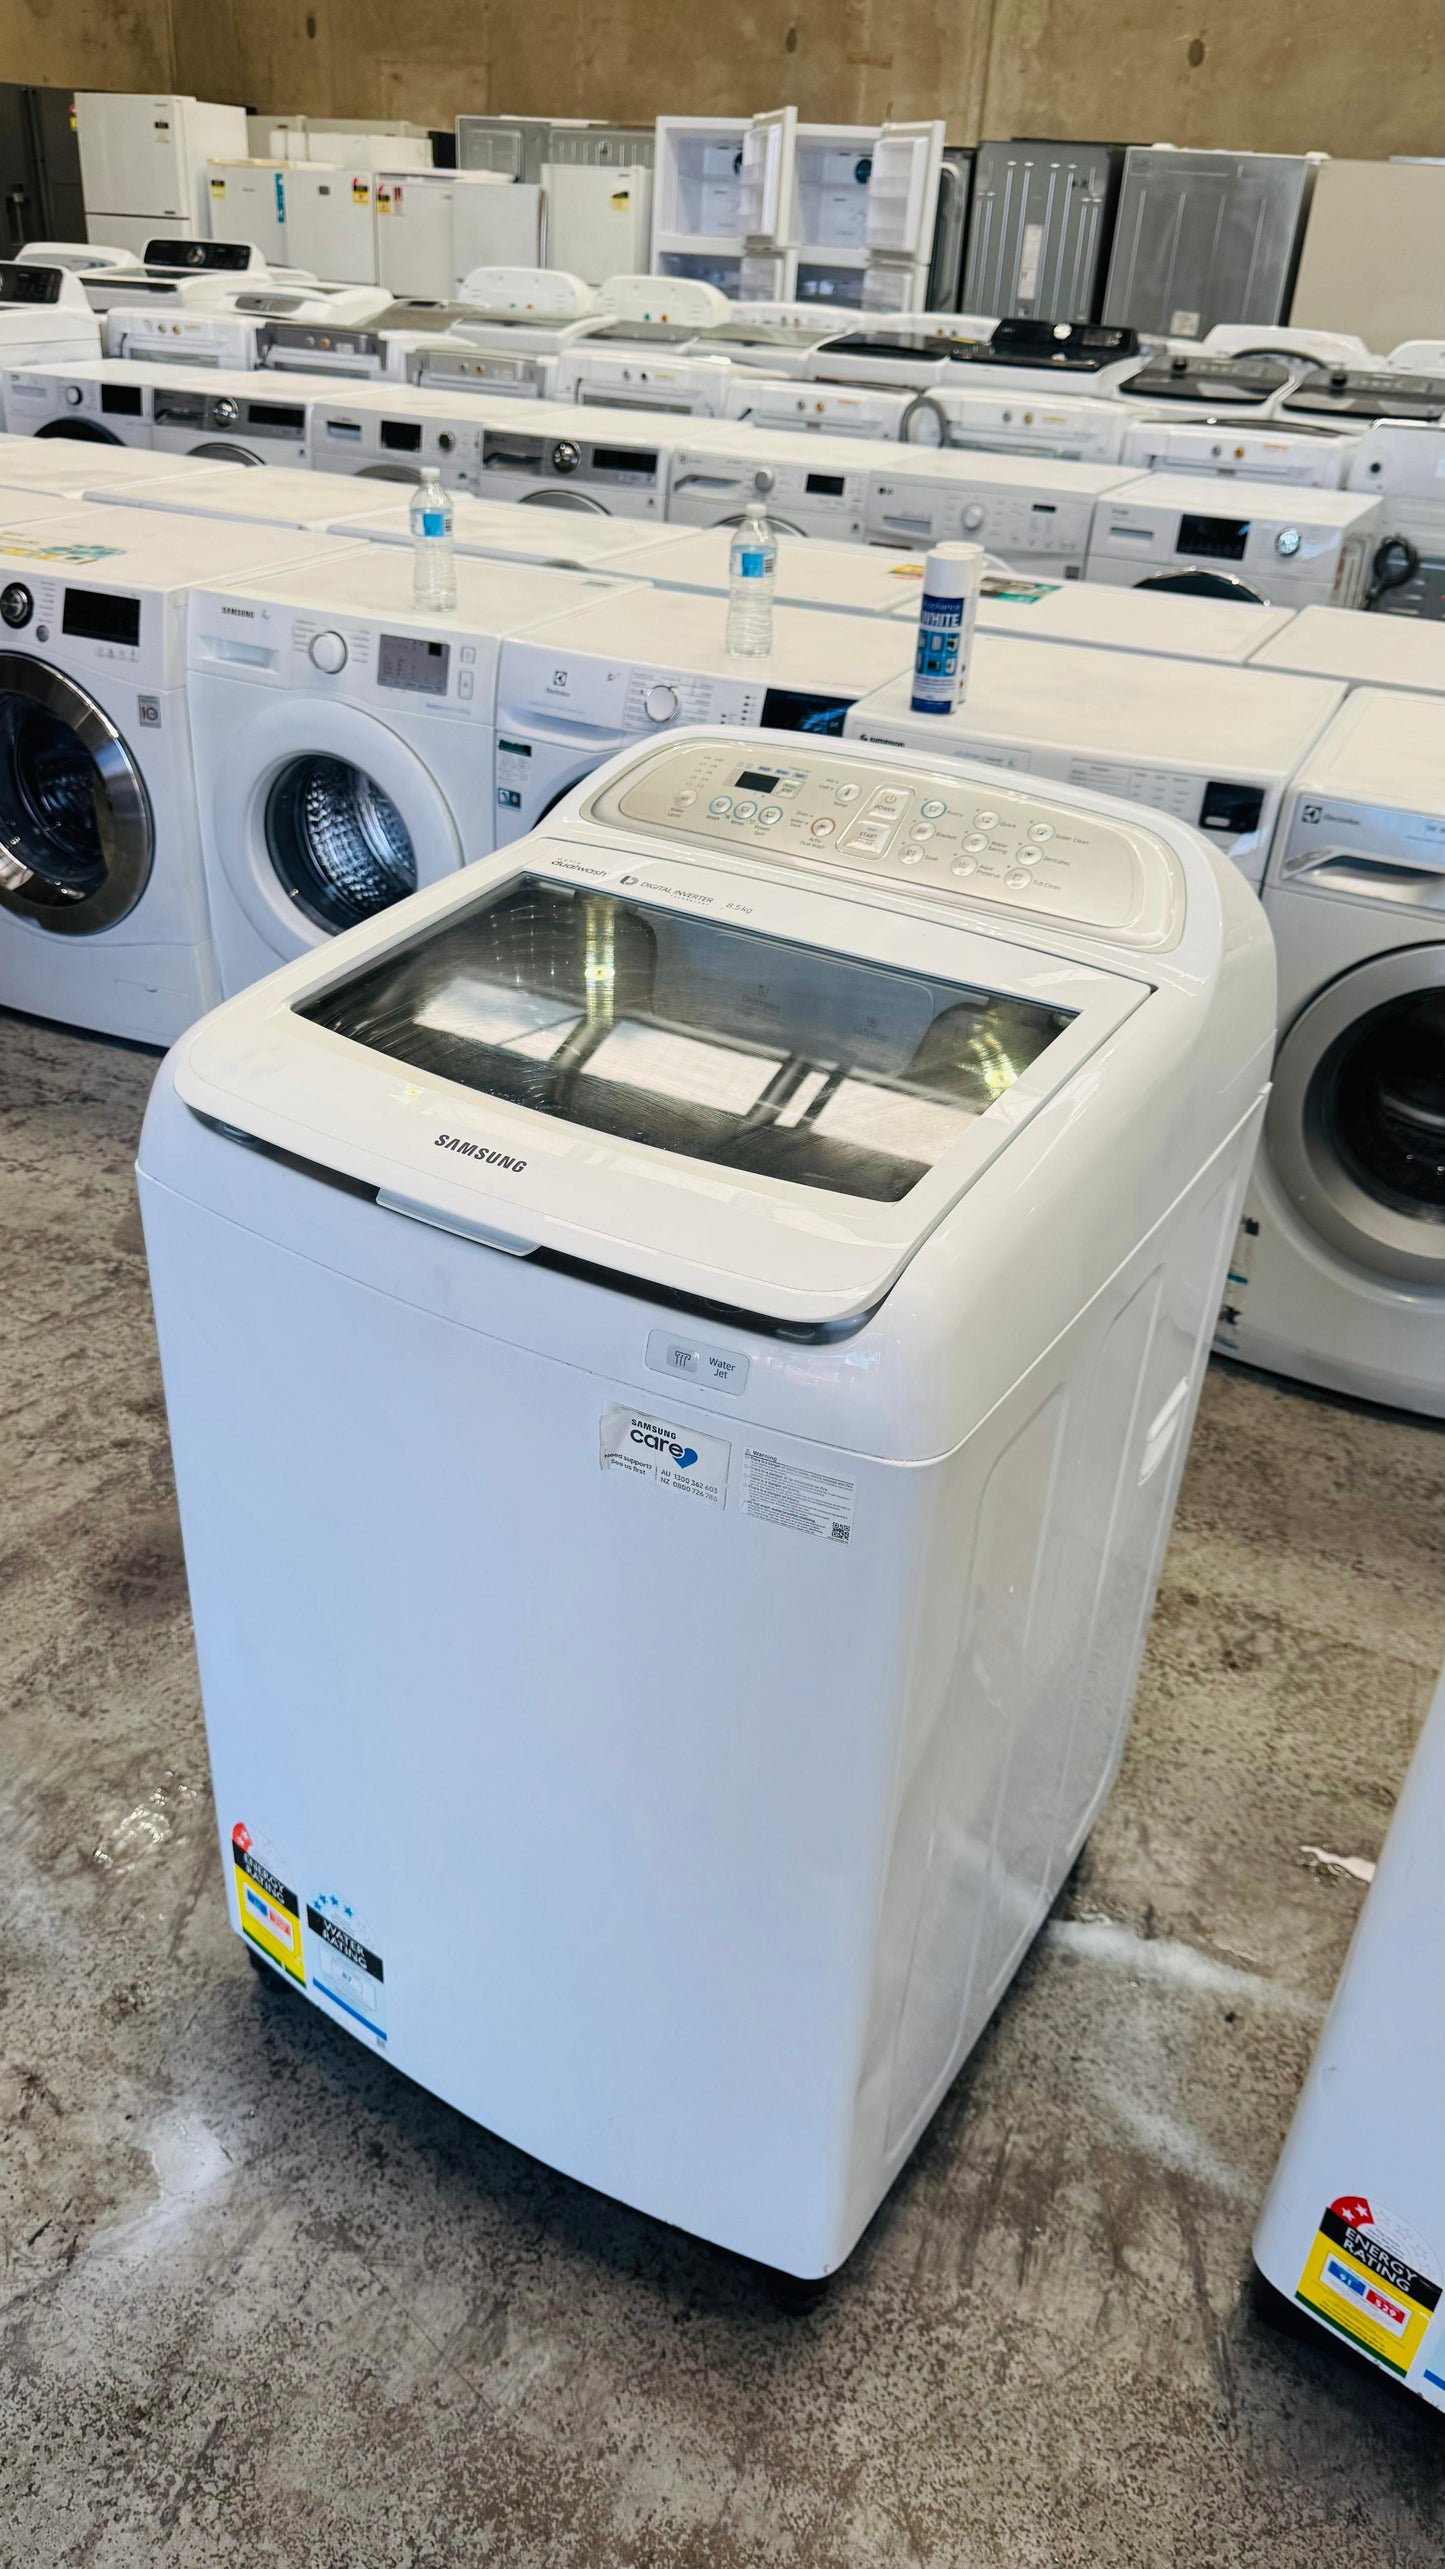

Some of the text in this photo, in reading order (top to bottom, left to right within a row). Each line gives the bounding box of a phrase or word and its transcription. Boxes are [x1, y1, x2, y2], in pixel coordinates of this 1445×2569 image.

[222, 606, 254, 619] SAMSUNG
[922, 610, 960, 627] WHITE
[874, 804, 896, 813] POWER
[551, 859, 607, 877] dualwash
[640, 881, 672, 894] DIGITAL
[673, 889, 714, 904] INVERTER
[434, 1134, 528, 1172] SAMSUNG
[709, 1356, 736, 1373] Water
[714, 1368, 728, 1380] Jet
[631, 1418, 677, 1440] SAMSUNG
[630, 1429, 684, 1458] care
[623, 1456, 652, 1470] support?
[752, 1450, 777, 1461] Warning
[611, 1459, 624, 1467] See
[633, 1466, 646, 1475] first
[660, 1477, 670, 1485] NZ
[672, 1481, 691, 1492] 0800
[691, 1488, 704, 1497] 726
[661, 1469, 718, 1494] AU 1300 362 603
[243, 1853, 286, 1894] ENERGY
[244, 1865, 286, 1905] RATING
[322, 1929, 368, 1970] RATING
[323, 1919, 366, 1958] WATER
[1343, 2238, 1411, 2292] RATING
[1345, 2227, 1418, 2281] ENERGY
